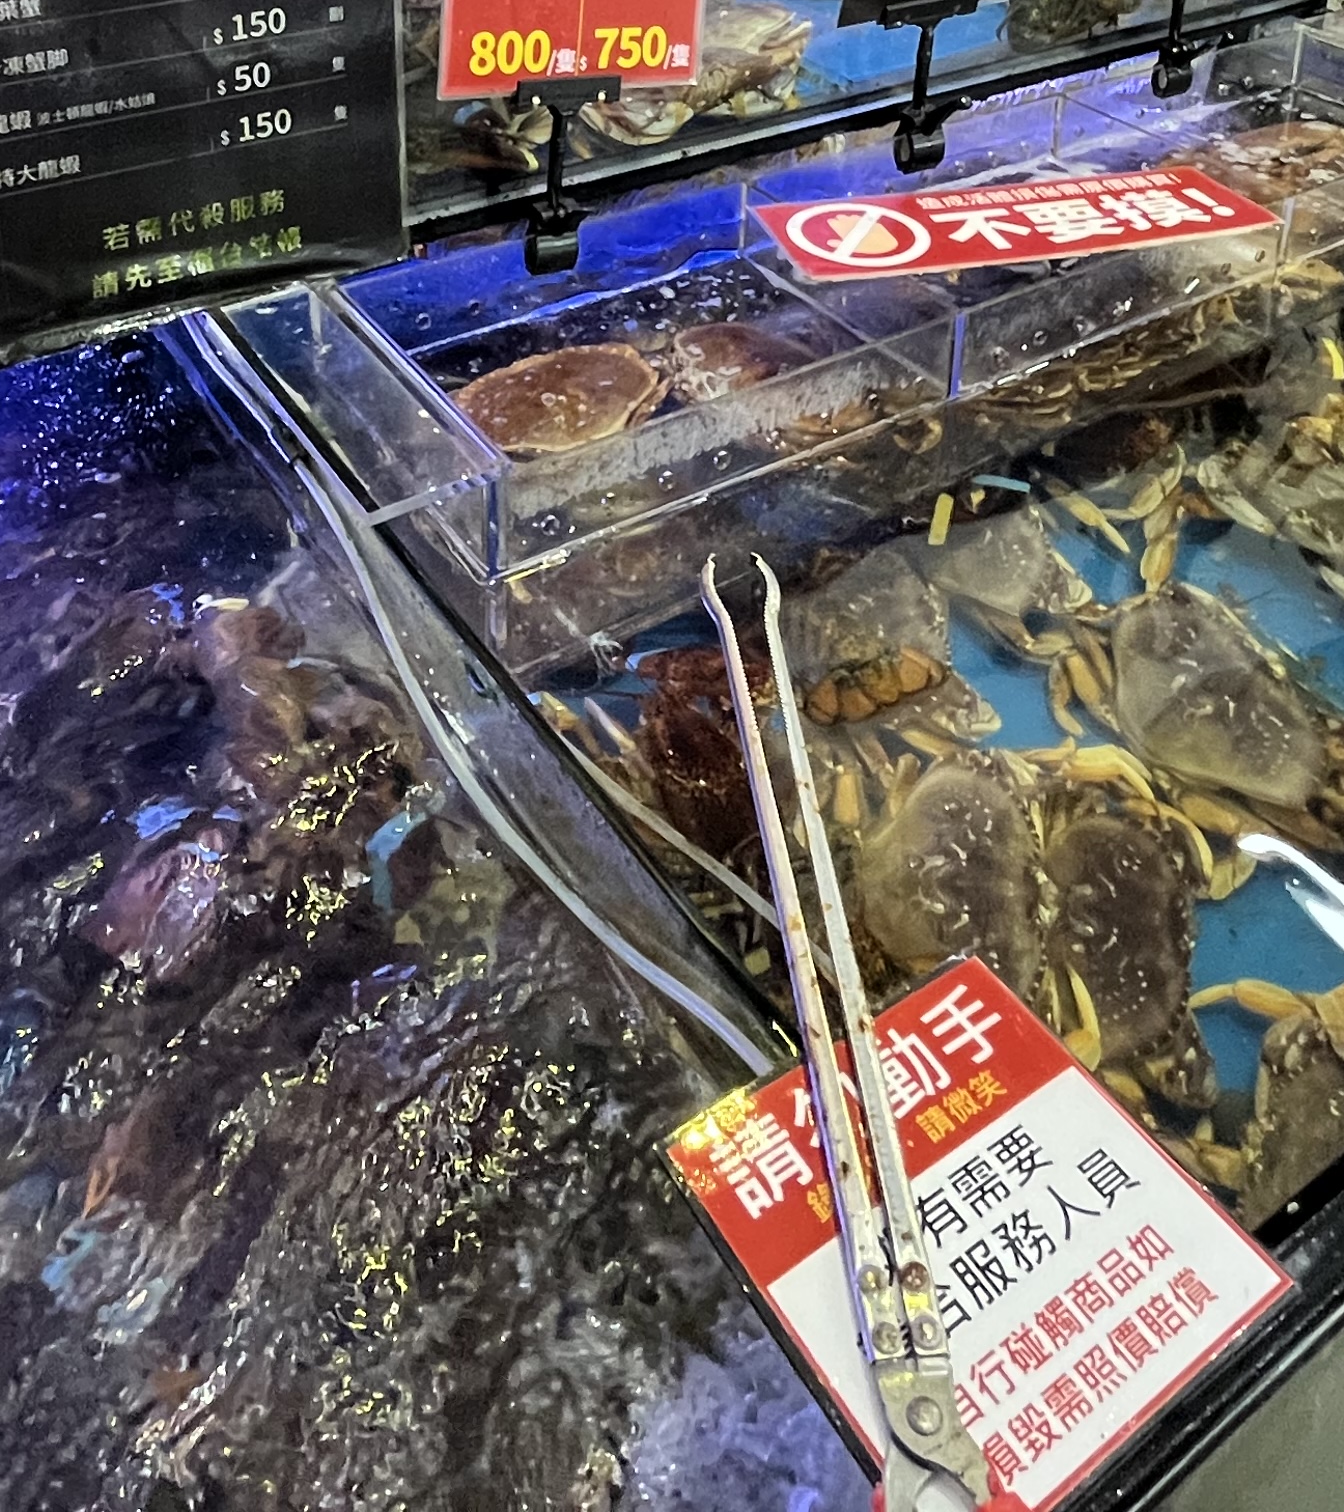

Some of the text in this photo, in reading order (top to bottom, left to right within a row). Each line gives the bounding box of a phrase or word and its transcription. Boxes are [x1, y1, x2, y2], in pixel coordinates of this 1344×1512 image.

[213, 27, 224, 45] $
[231, 7, 287, 41] 150
[217, 79, 228, 96] $
[234, 61, 271, 92] 50
[220, 129, 231, 146] $
[238, 108, 292, 143] 150
[102, 189, 285, 251] 若需代殺服務
[929, 188, 1236, 250] 不要摸!
[914, 1069, 1008, 1144] 請微笑
